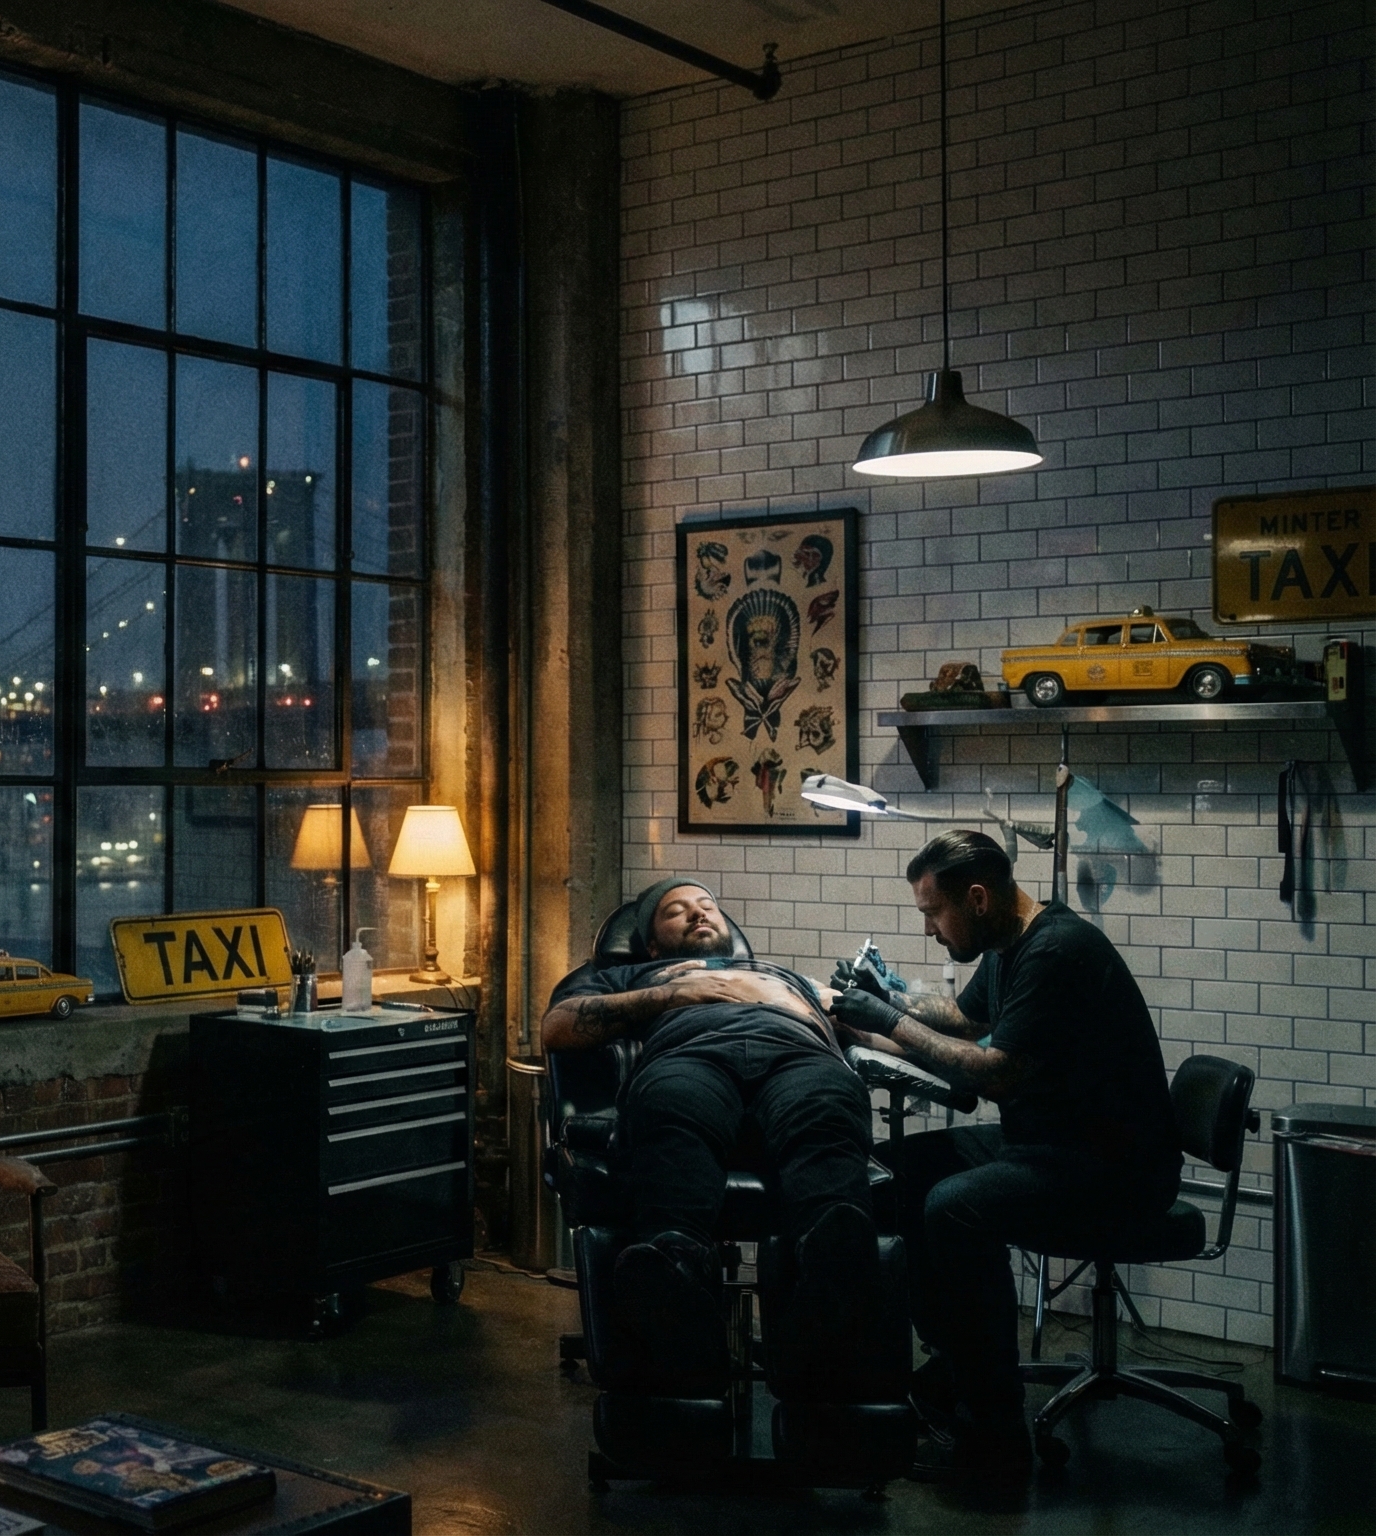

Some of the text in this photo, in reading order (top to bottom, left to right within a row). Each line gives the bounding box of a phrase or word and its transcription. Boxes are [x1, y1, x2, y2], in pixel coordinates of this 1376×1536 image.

[1260, 509, 1361, 536] MINTER
[1239, 542, 1376, 602] TAXI
[143, 924, 268, 986] TAXI
